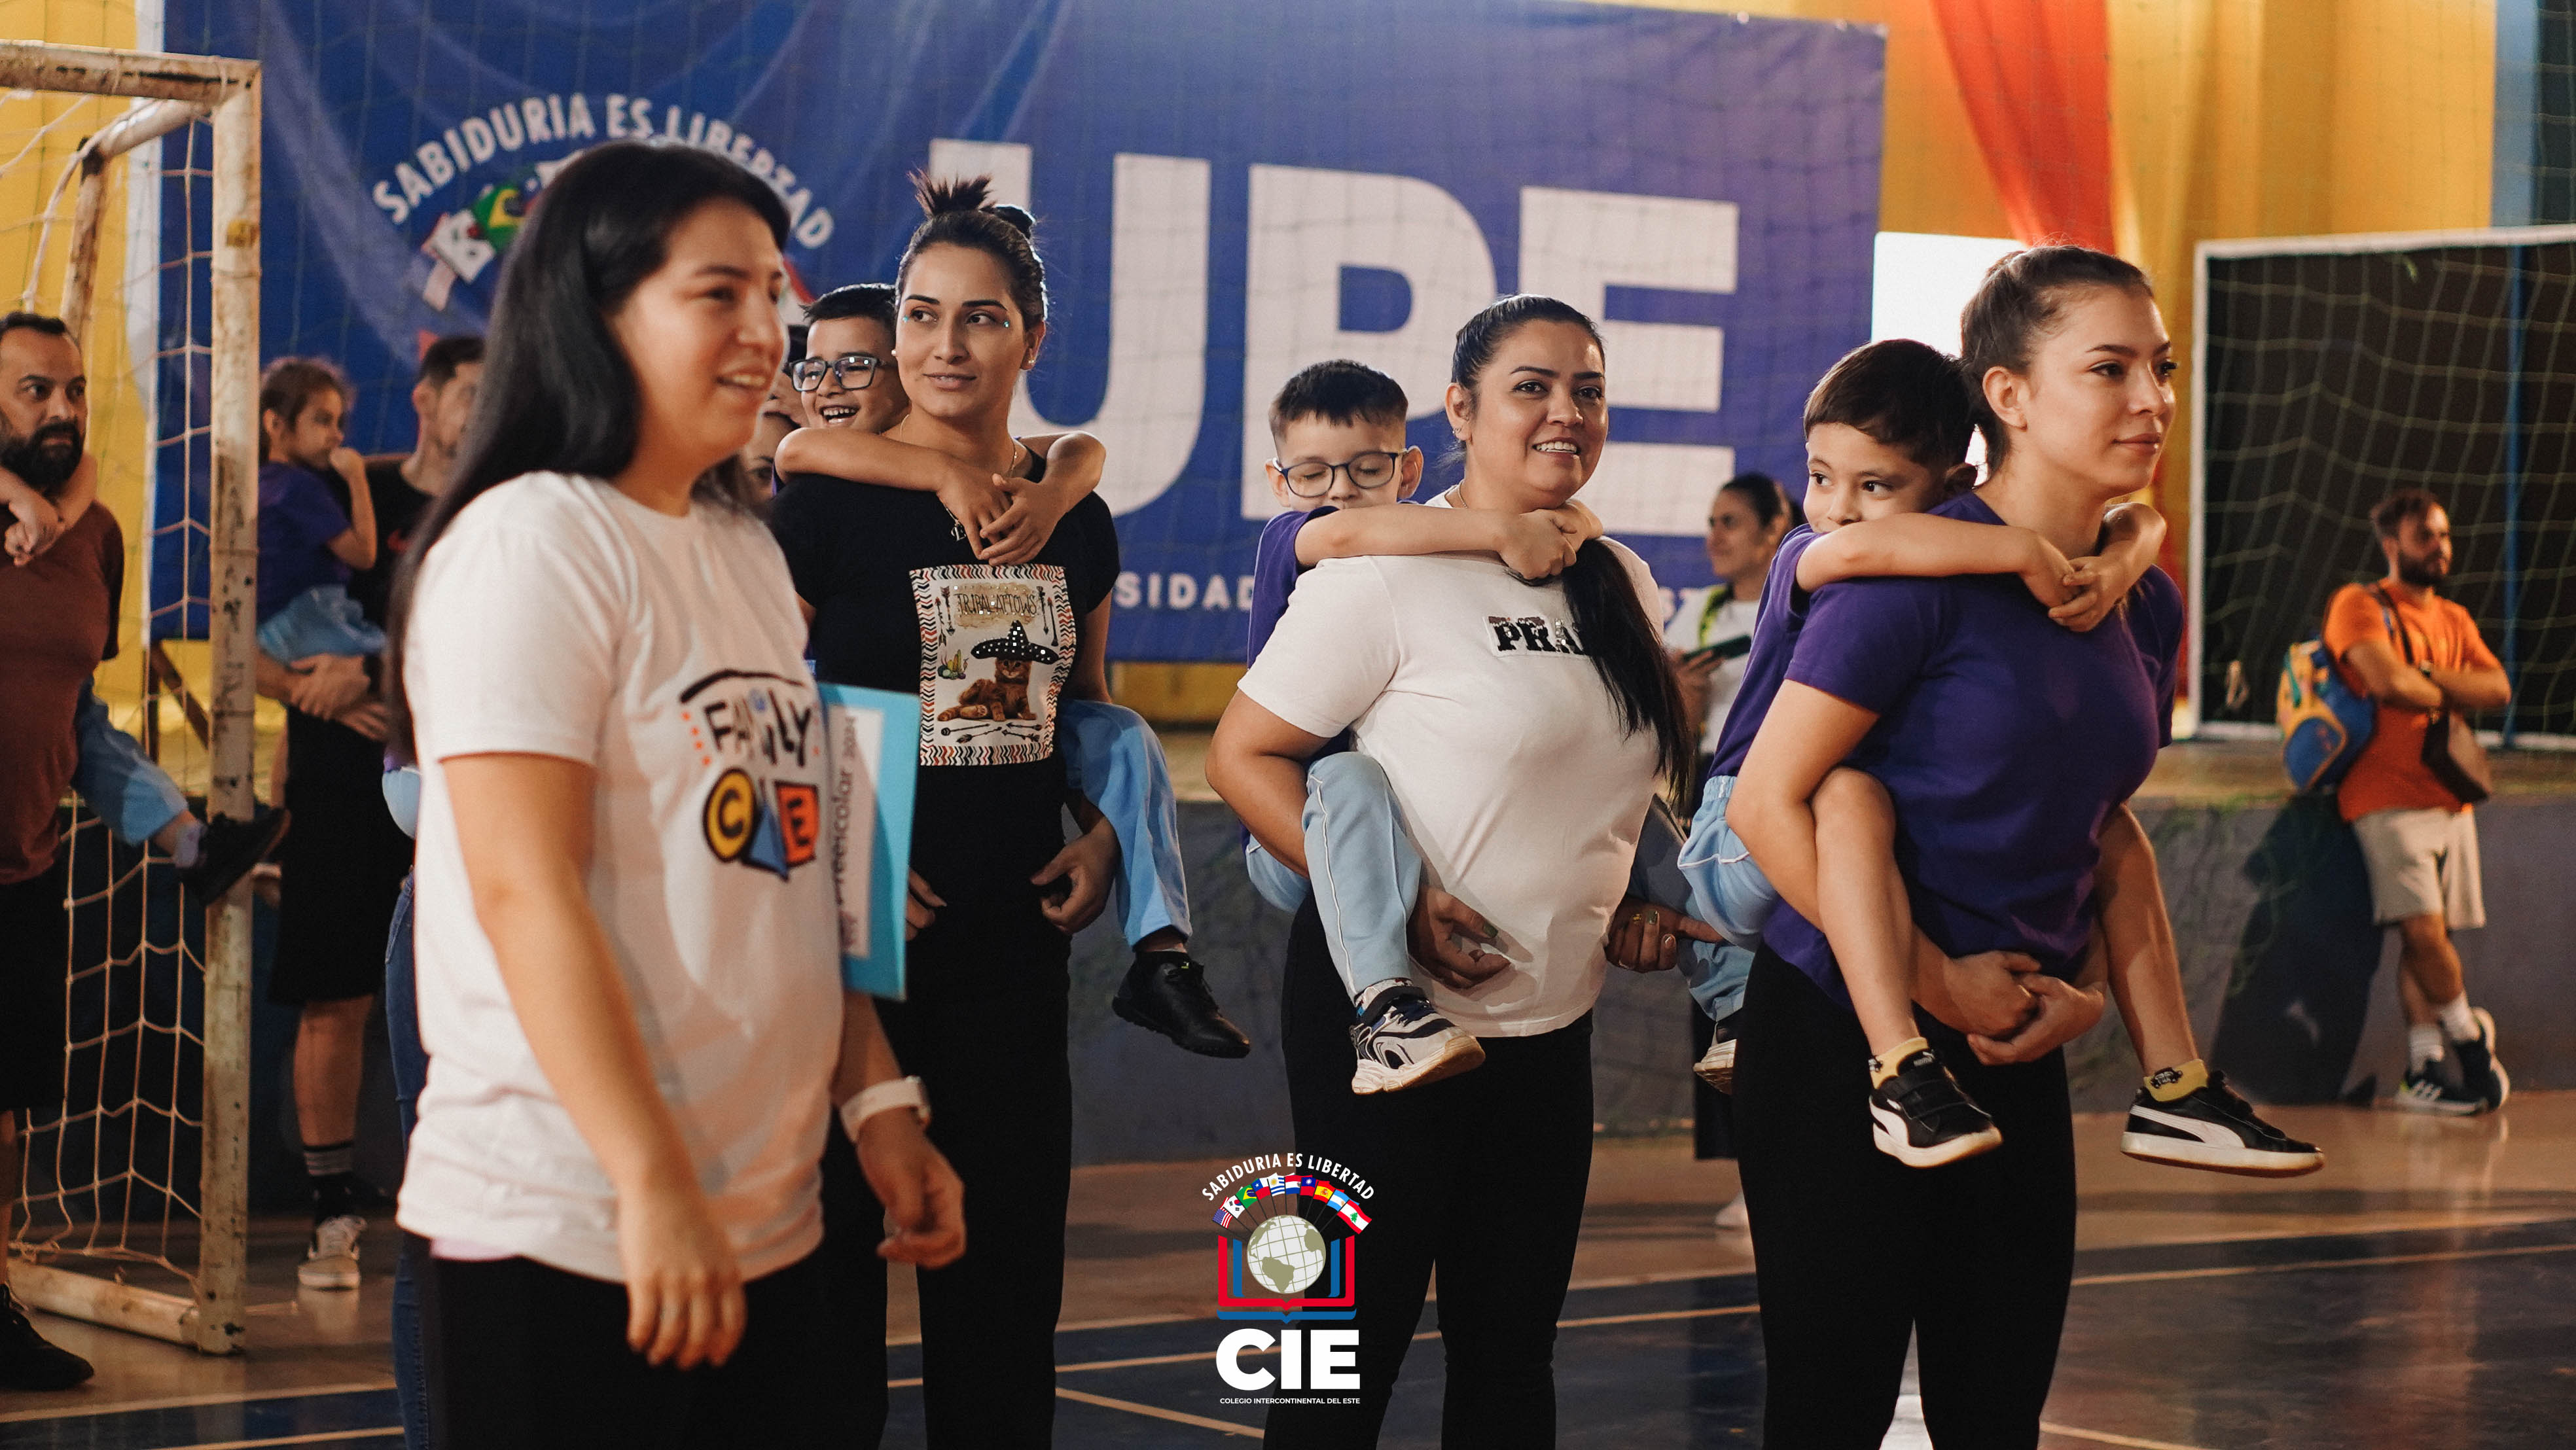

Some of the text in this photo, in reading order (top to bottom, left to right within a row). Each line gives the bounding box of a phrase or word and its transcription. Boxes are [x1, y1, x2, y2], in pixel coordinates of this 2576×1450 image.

[372, 92, 596, 225] SABIDURIA
[605, 93, 654, 139] ES
[926, 137, 1740, 537] UPE
[954, 592, 995, 615] TRIBAL
[1114, 571, 1255, 611] SIDAD
[1488, 616, 1584, 655] PRA
[704, 688, 810, 767] FAILY
